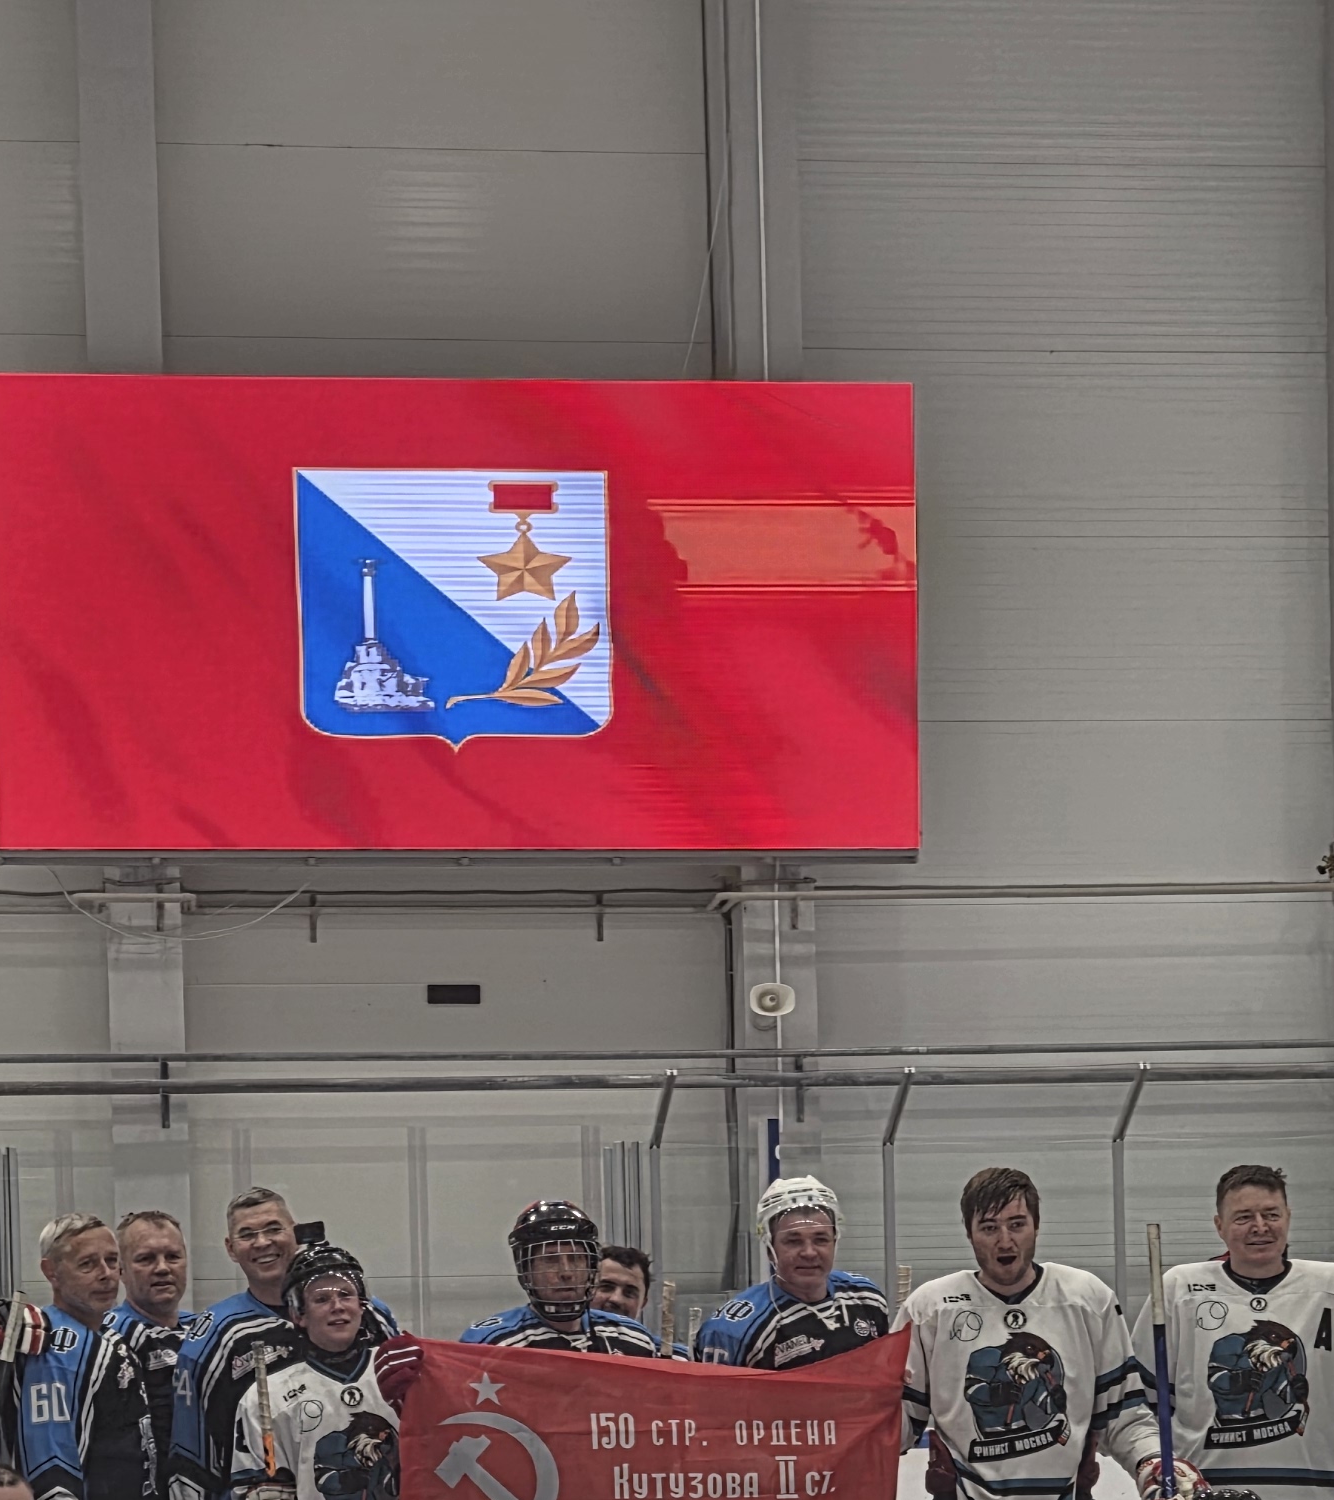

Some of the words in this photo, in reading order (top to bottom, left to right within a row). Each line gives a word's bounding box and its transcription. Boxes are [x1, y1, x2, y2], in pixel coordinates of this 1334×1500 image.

[29, 1382, 71, 1424] 60
[590, 1412, 636, 1450] 150
[734, 1419, 838, 1446] ОРДЕНА
[1014, 1431, 1054, 1453] МОСКВА
[1253, 1421, 1293, 1441] МОСКВА
